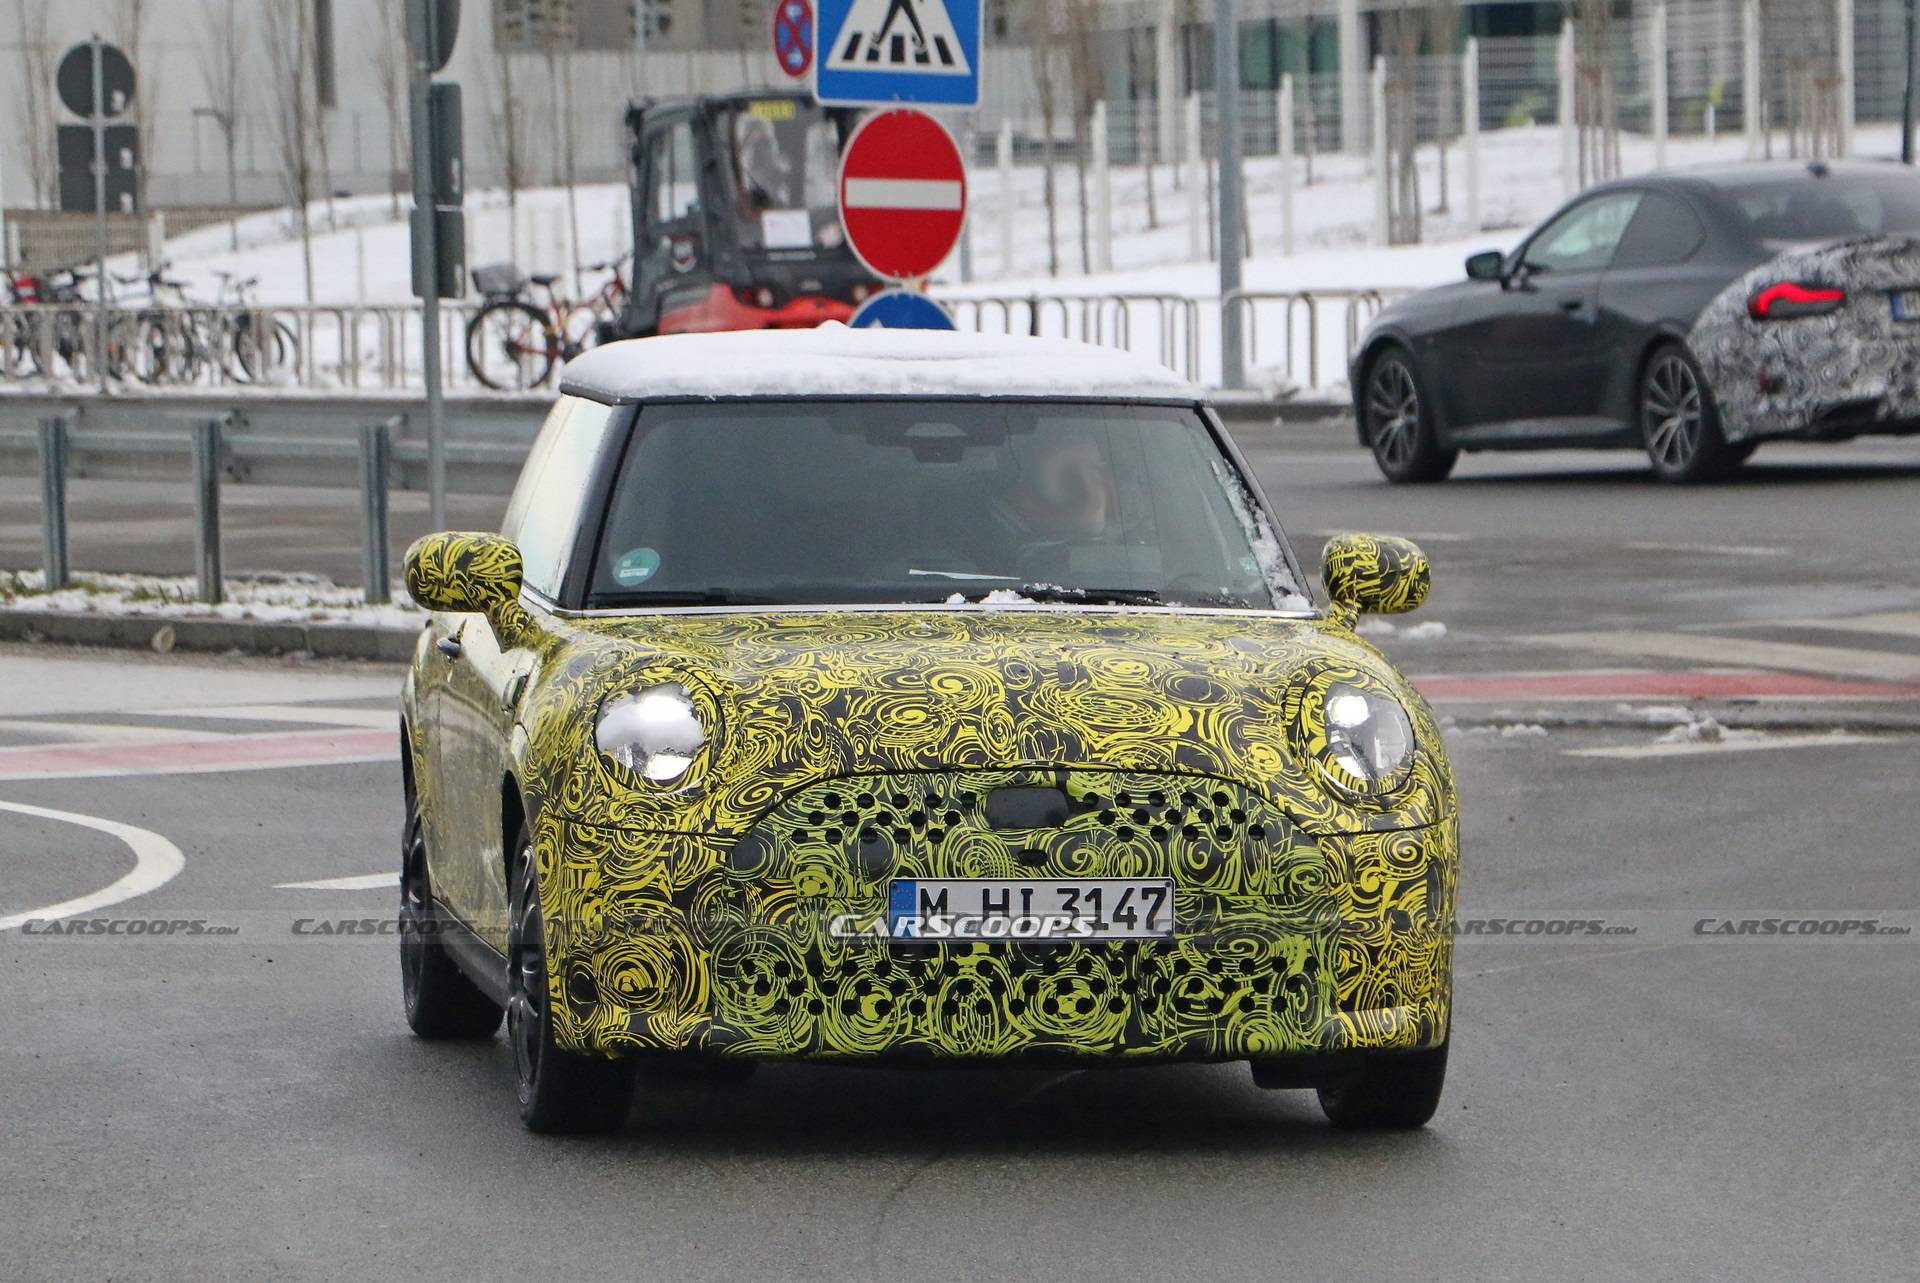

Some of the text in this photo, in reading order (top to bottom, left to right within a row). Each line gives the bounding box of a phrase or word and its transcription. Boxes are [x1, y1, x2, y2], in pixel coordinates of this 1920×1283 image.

[919, 886, 949, 932] M
[981, 886, 1036, 932] HI
[1056, 886, 1169, 931] 3147
